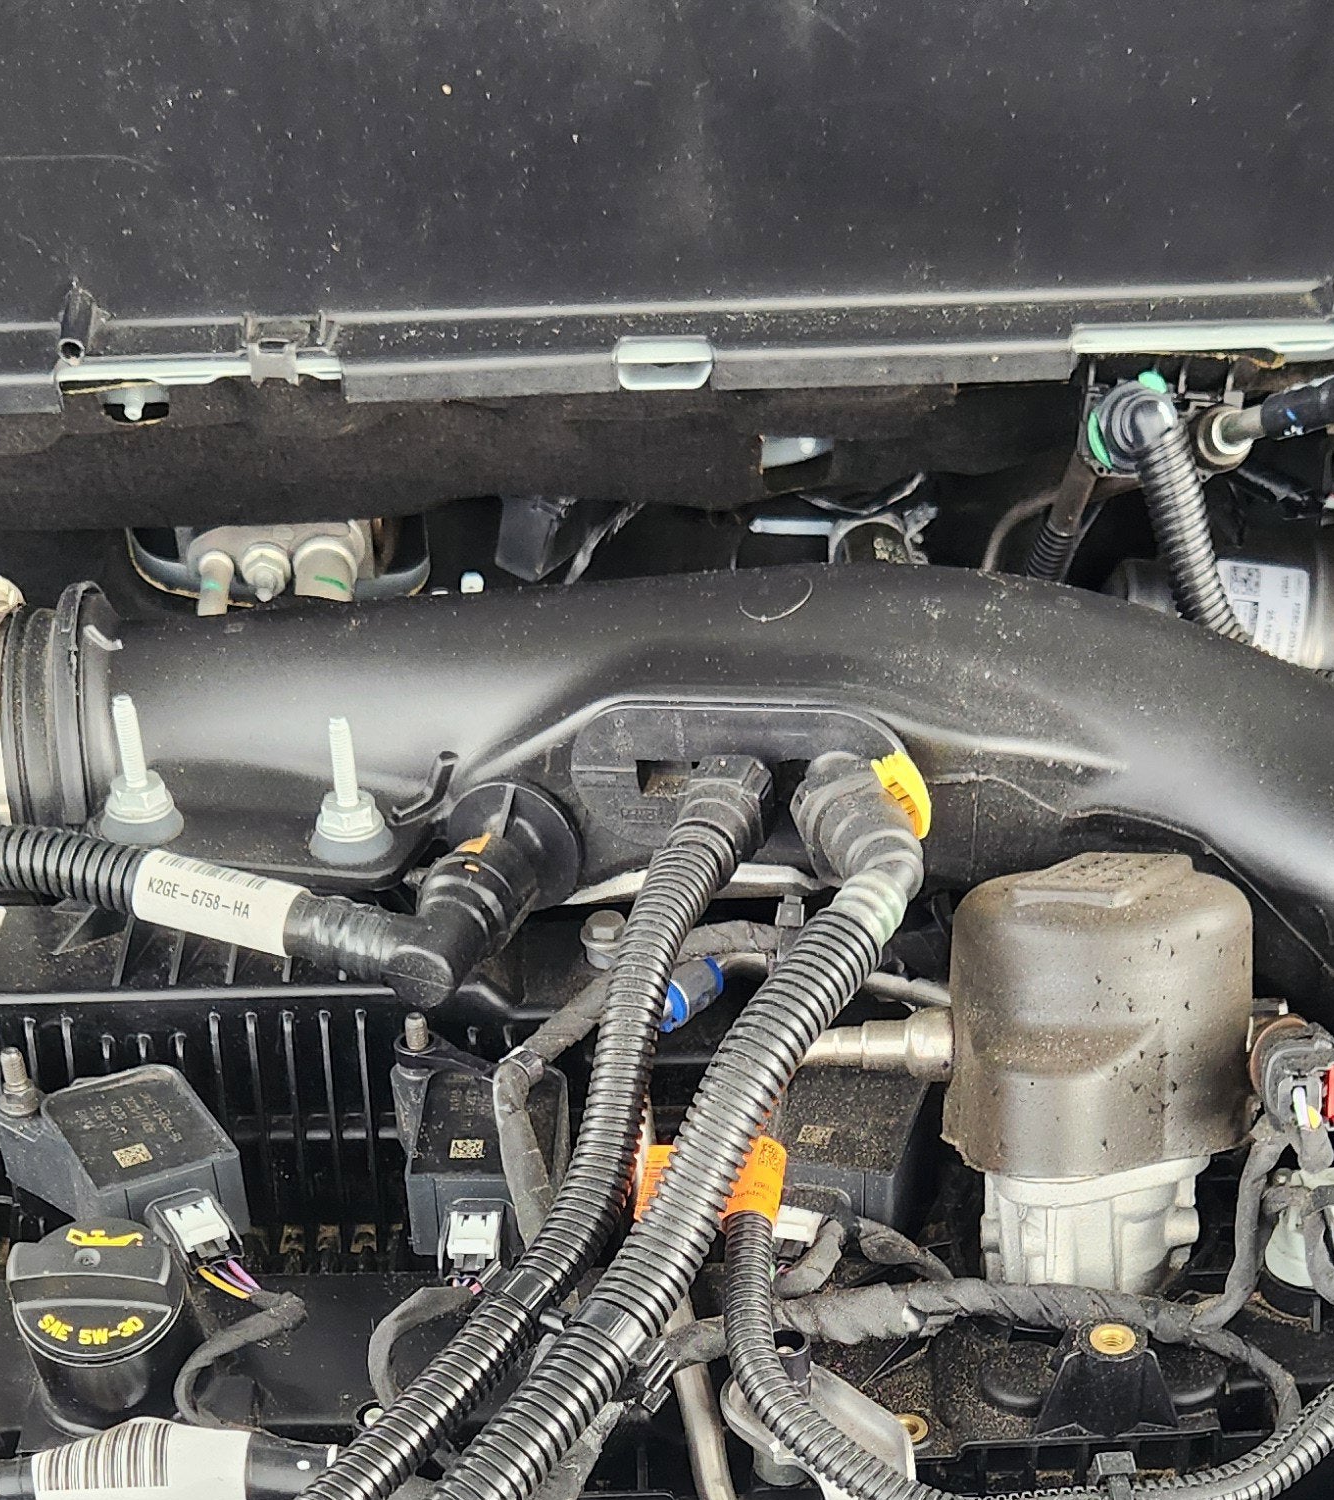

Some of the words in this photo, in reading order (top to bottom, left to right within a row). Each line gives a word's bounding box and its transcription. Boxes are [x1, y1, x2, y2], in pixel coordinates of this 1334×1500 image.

[147, 876, 251, 919] K2GE-6758-HA
[38, 1313, 74, 1342] SAE
[78, 1315, 145, 1345] 5W-30
